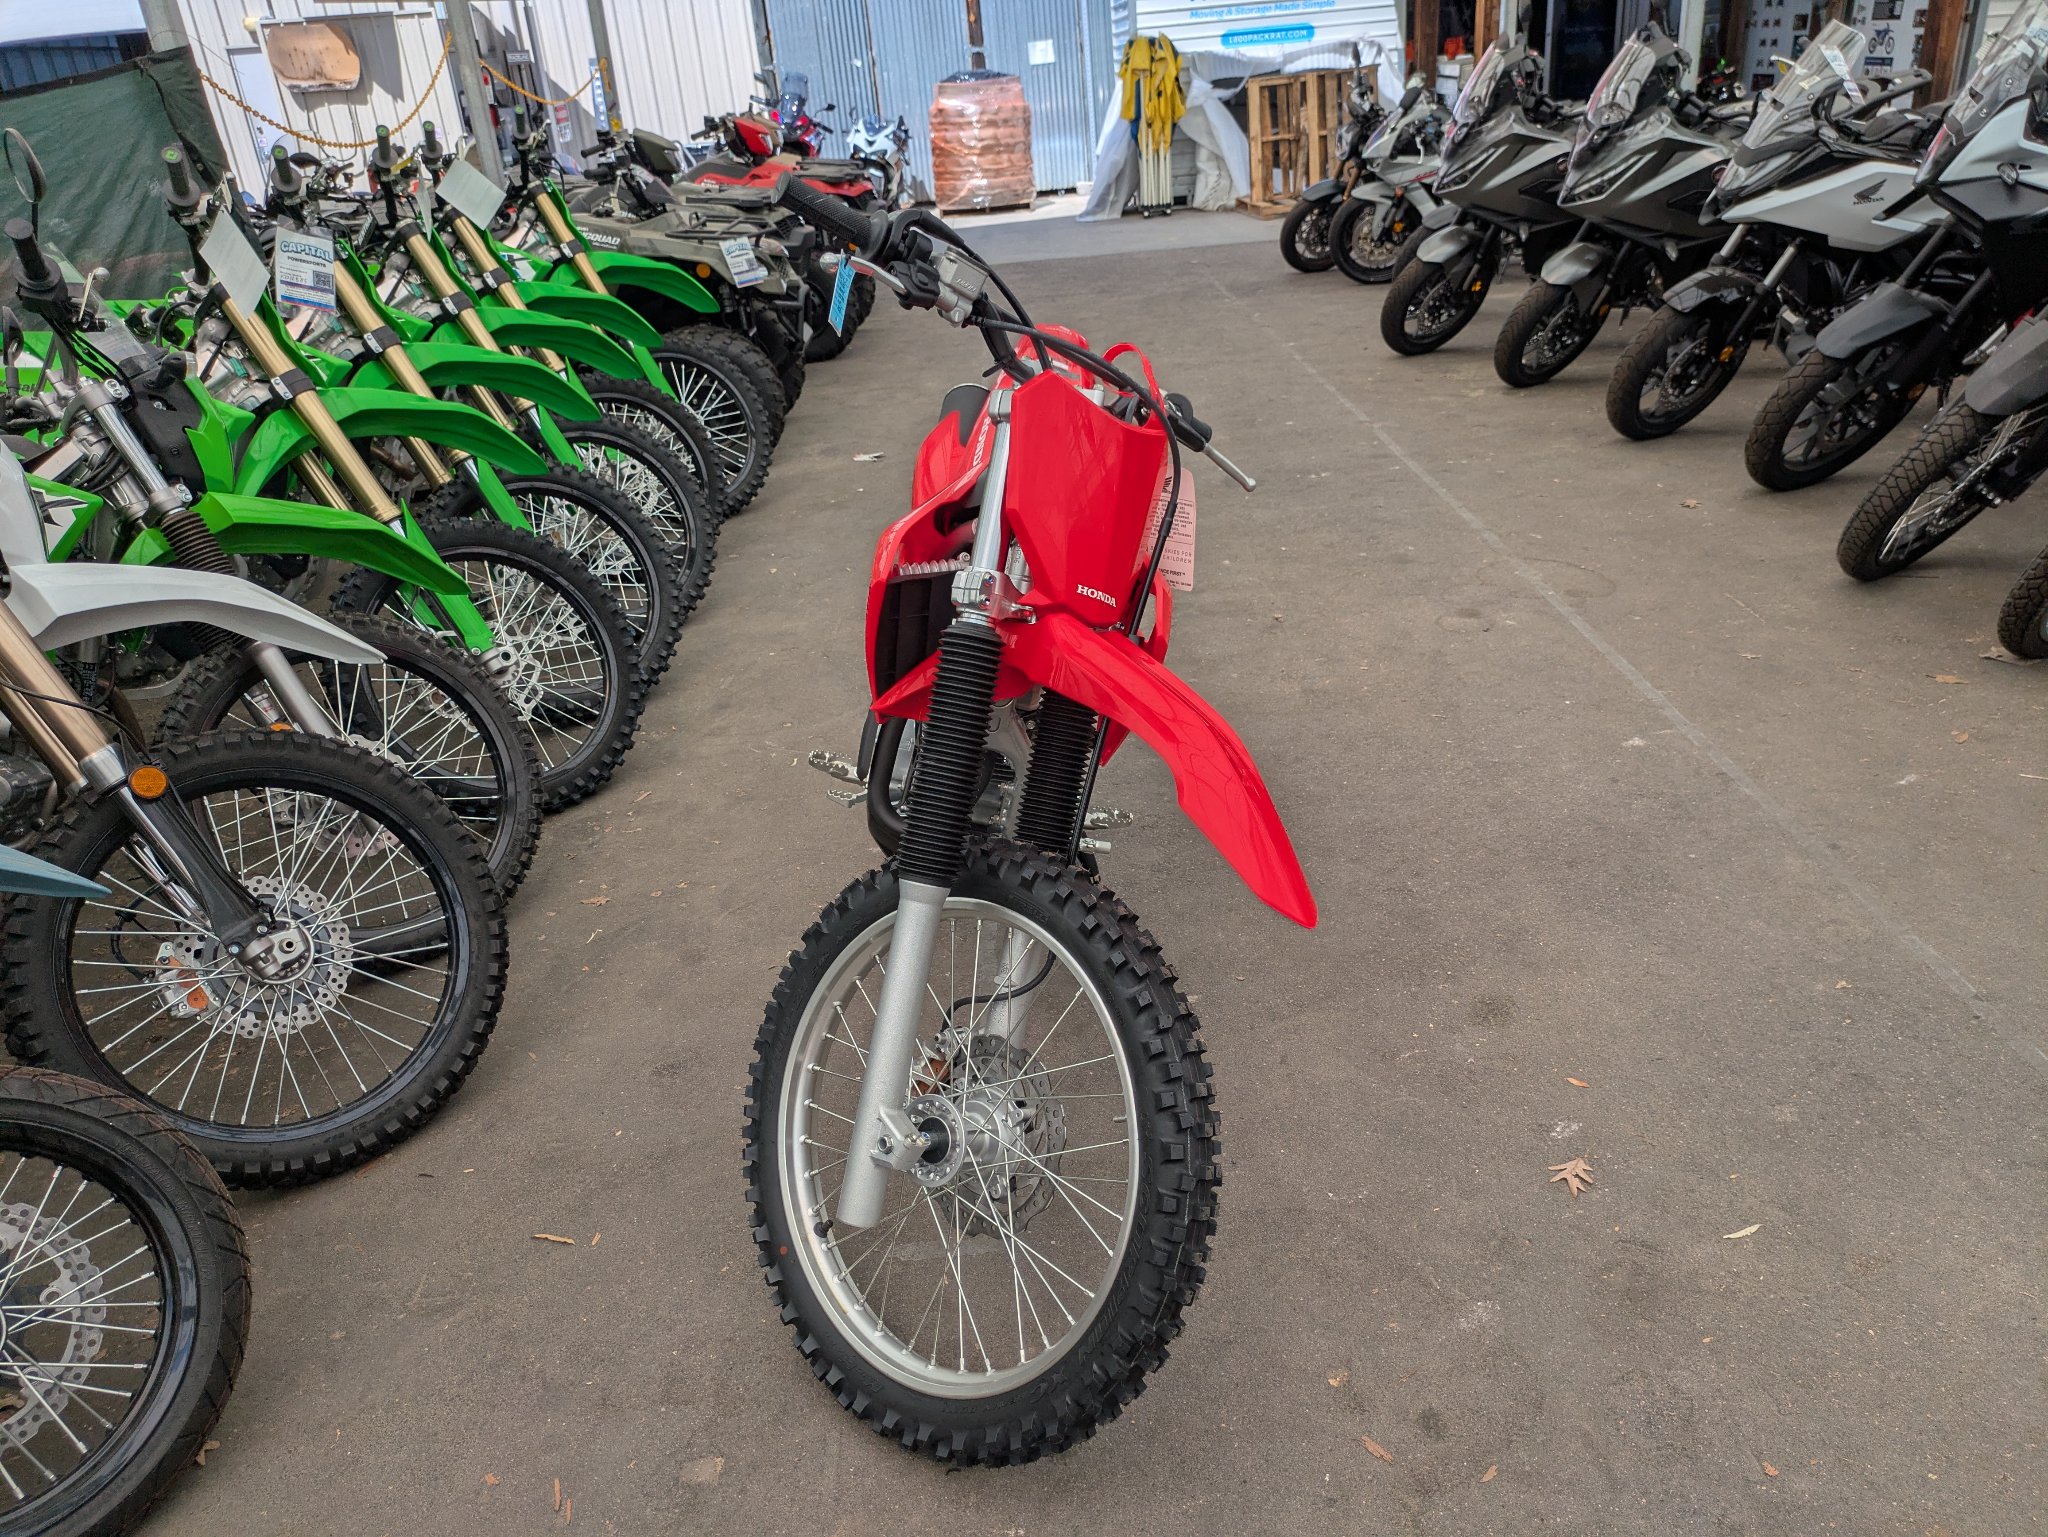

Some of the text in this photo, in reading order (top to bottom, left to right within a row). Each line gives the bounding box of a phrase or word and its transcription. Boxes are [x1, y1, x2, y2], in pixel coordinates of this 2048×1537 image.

[1189, 9, 1224, 19] Moving
[1234, 4, 1273, 16] Storage
[1274, 2, 1300, 12] Made
[1302, 0, 1336, 10] Simple
[281, 240, 334, 264] CAPITAL
[287, 255, 327, 268] POWERSPORTS
[1164, 548, 1180, 556] SKIES
[1076, 584, 1117, 607] HONDA
